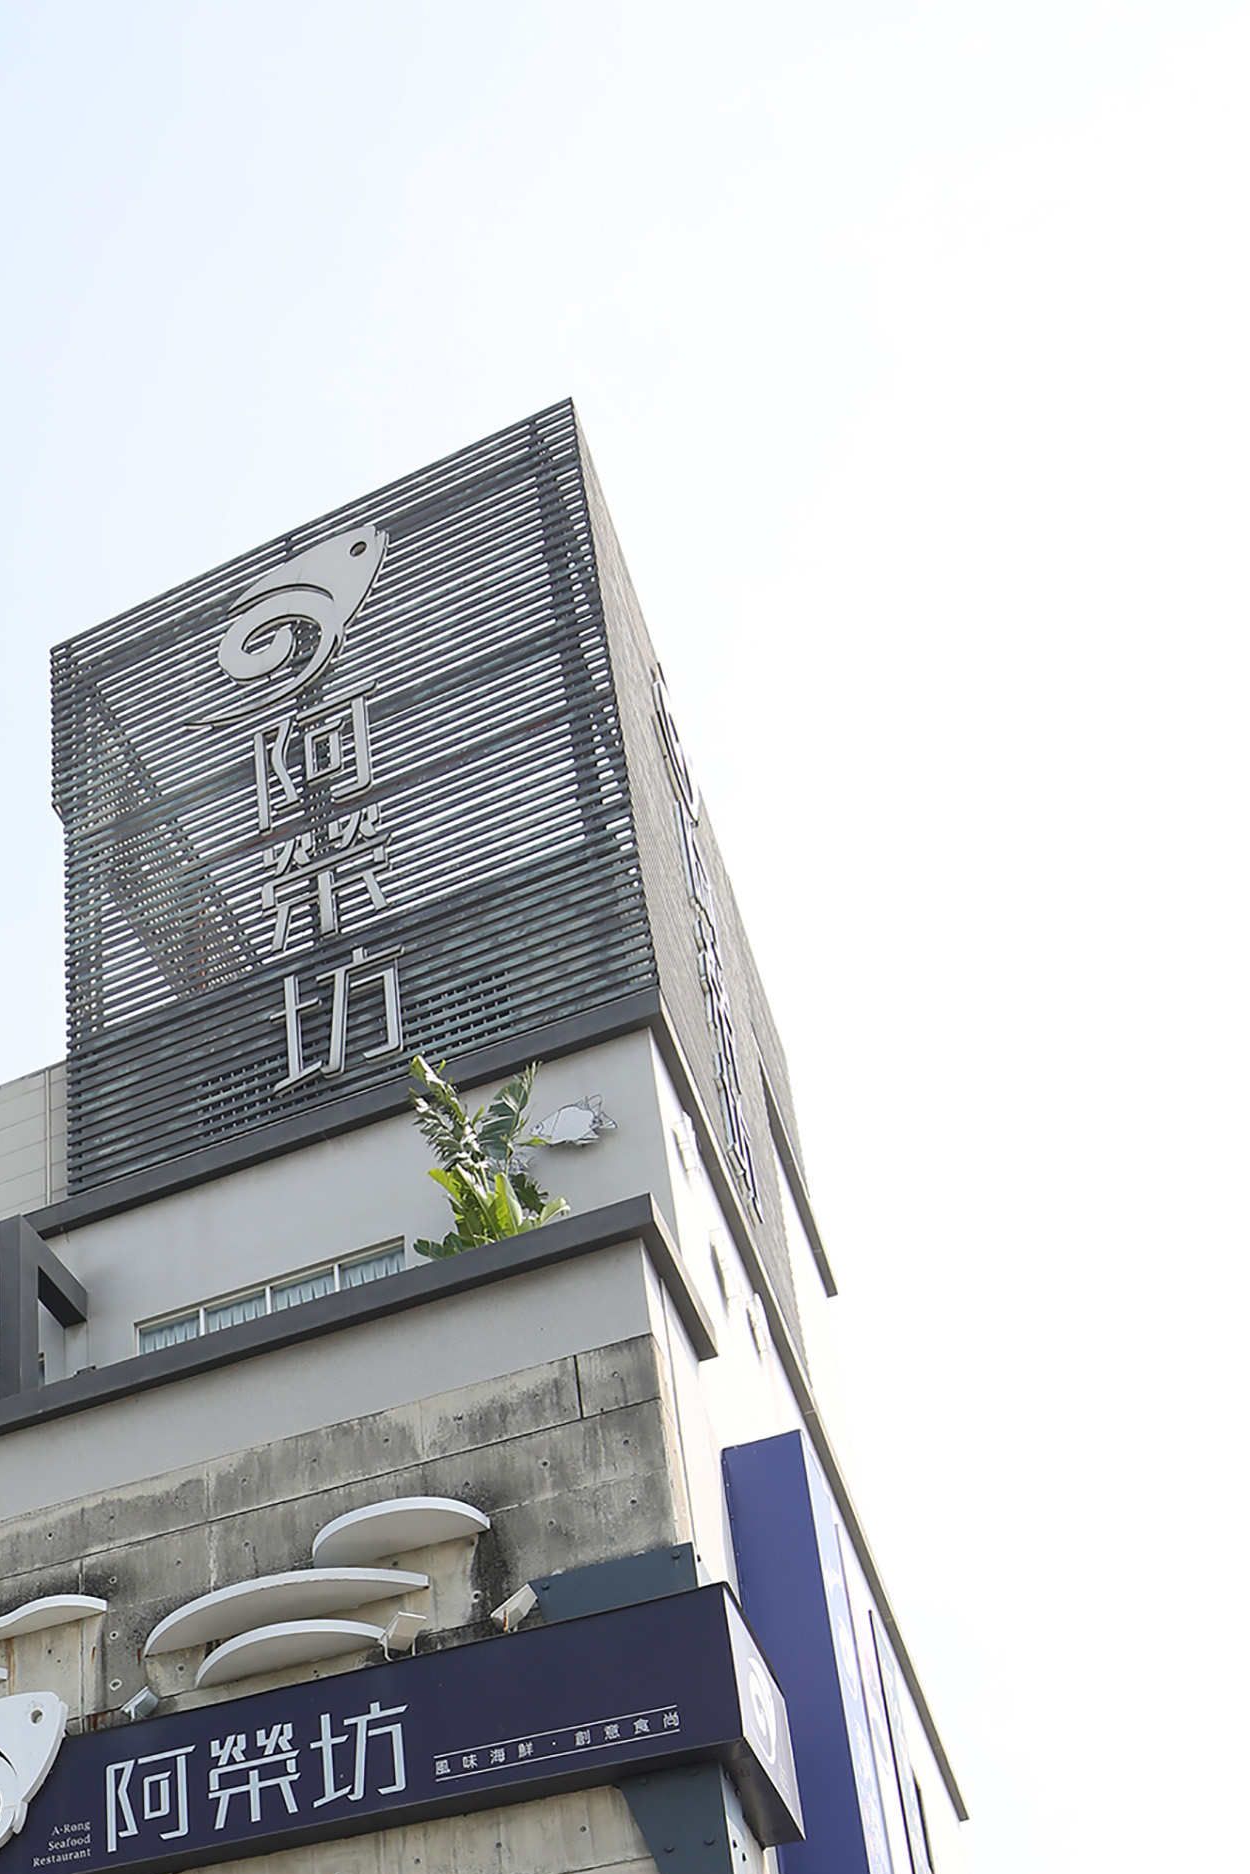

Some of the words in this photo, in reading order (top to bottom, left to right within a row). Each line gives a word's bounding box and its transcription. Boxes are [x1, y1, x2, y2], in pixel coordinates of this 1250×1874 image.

[254, 681, 405, 1096] 阿榮坊
[105, 1701, 408, 1853] 阿榮坊
[32, 1848, 91, 1868] Restaurant
[48, 1834, 91, 1851] Seafood
